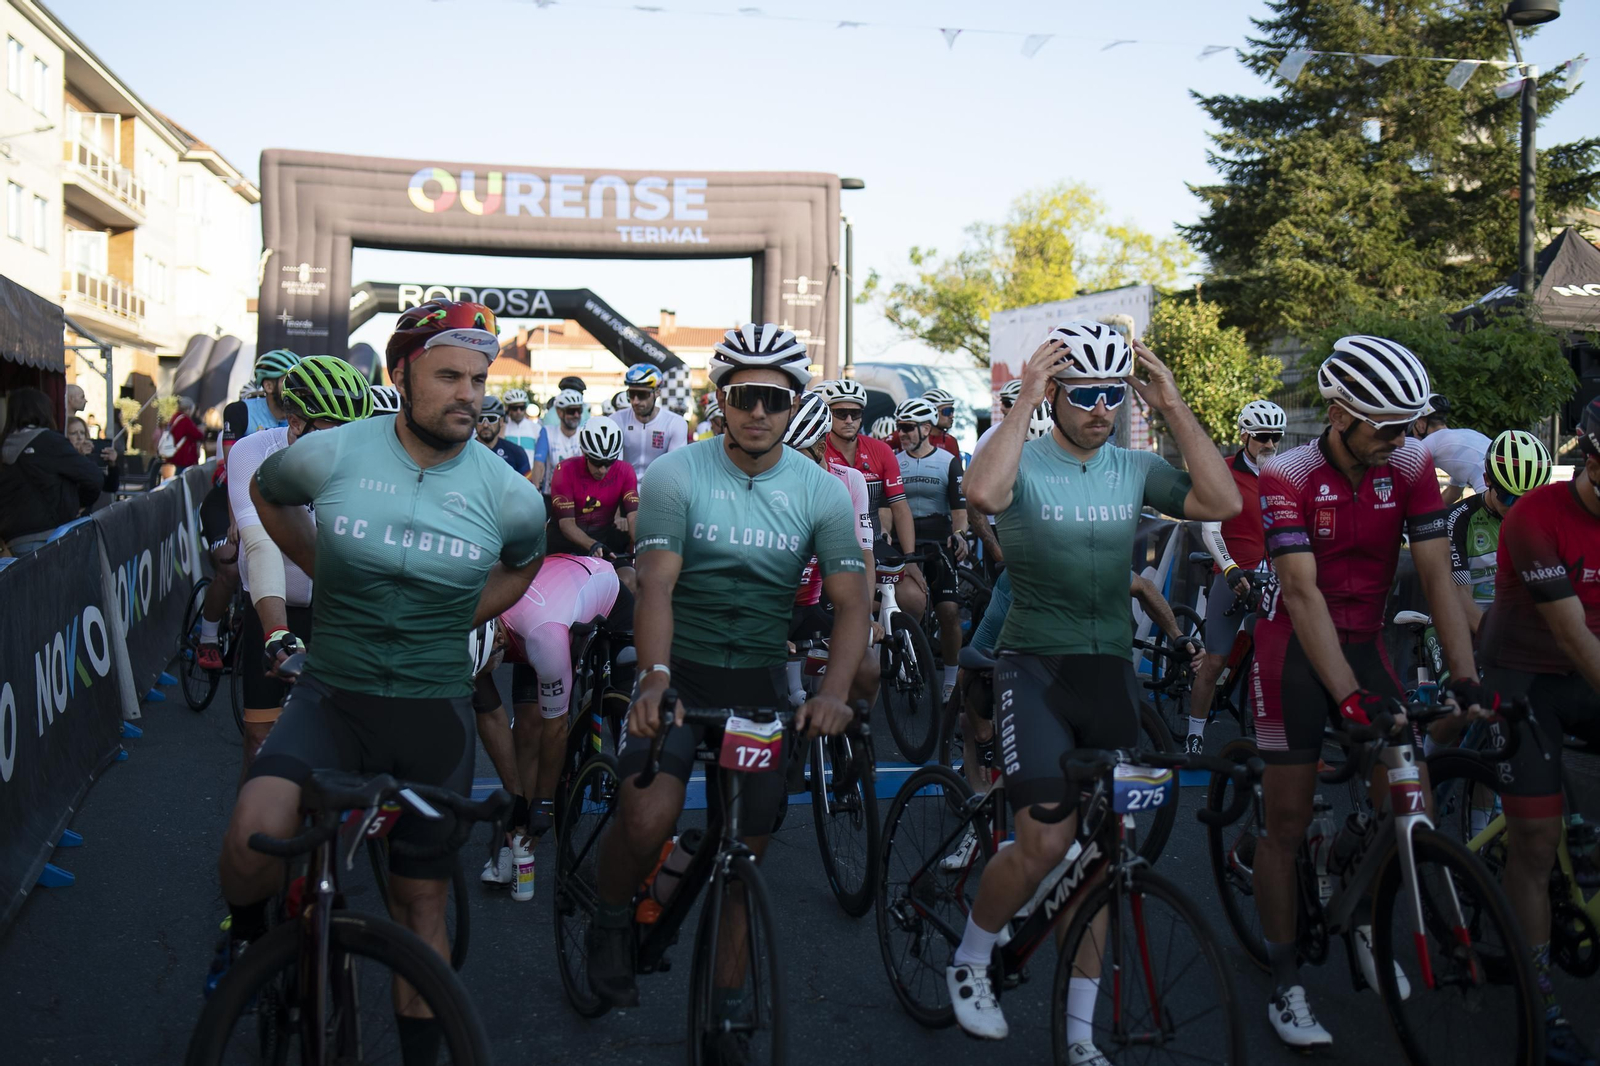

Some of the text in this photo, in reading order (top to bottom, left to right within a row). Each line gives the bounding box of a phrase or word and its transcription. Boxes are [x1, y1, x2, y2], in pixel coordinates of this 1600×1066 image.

[407, 166, 708, 222] OURENSE
[616, 225, 709, 244] TERMAL
[398, 284, 554, 316] RODOSA
[585, 299, 666, 363] www.rodosa.com
[1041, 503, 1134, 522] CC LOBIOS
[334, 515, 369, 539] CC
[384, 525, 482, 561] LOBIOS
[692, 522, 801, 552] CC LOBIOS
[1001, 688, 1021, 777] CC LOBIOS
[736, 745, 773, 768] 172
[1126, 785, 1166, 811] 275
